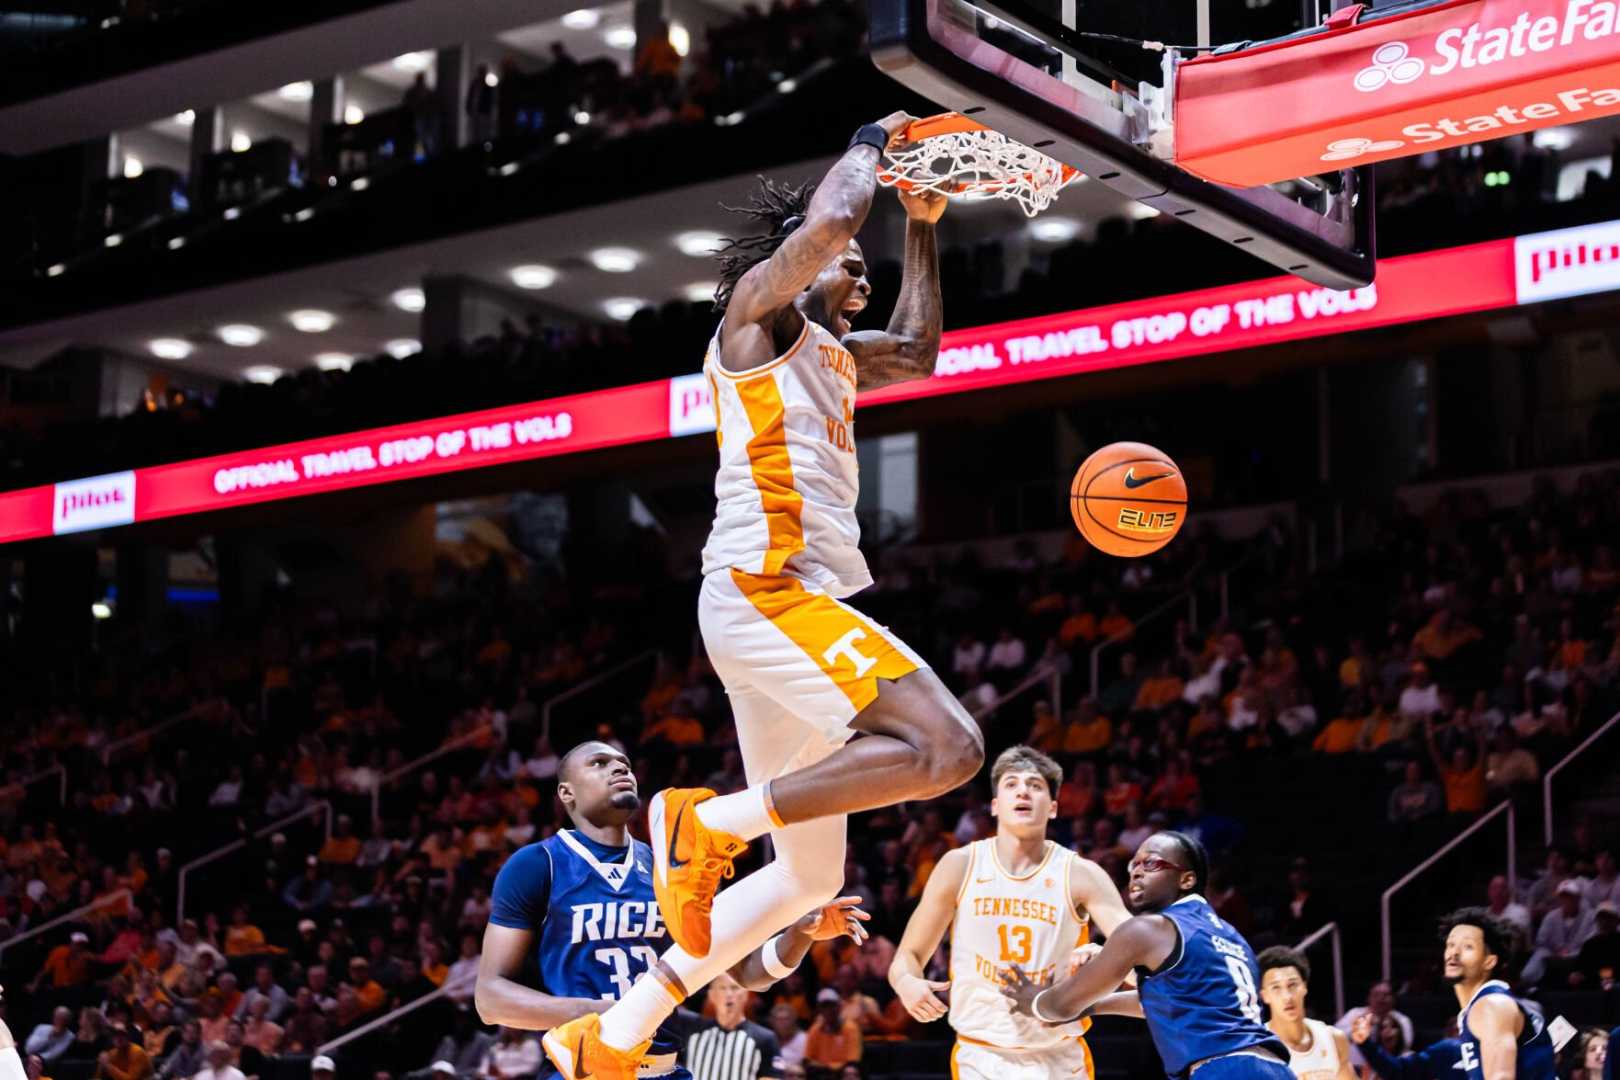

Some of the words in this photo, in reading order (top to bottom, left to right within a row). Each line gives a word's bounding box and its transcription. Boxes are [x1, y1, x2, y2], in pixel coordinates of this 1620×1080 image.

[1429, 12, 1558, 76] State
[1401, 102, 1559, 142] State
[1004, 325, 1108, 365] TRAVEL
[1112, 312, 1188, 349] STOP
[1190, 304, 1230, 337] OF
[1234, 293, 1295, 329] THE
[213, 459, 299, 494] OFFICIAL
[301, 446, 377, 478] TRAVEL
[379, 436, 434, 466] STOP
[436, 430, 466, 457] OF
[467, 422, 512, 452] THE
[514, 412, 572, 444] VOLS
[1119, 508, 1177, 531] ELITE
[822, 627, 878, 678] T
[570, 901, 666, 944] RICE
[973, 897, 1057, 926] TENNESSEE
[997, 924, 1033, 964] 13
